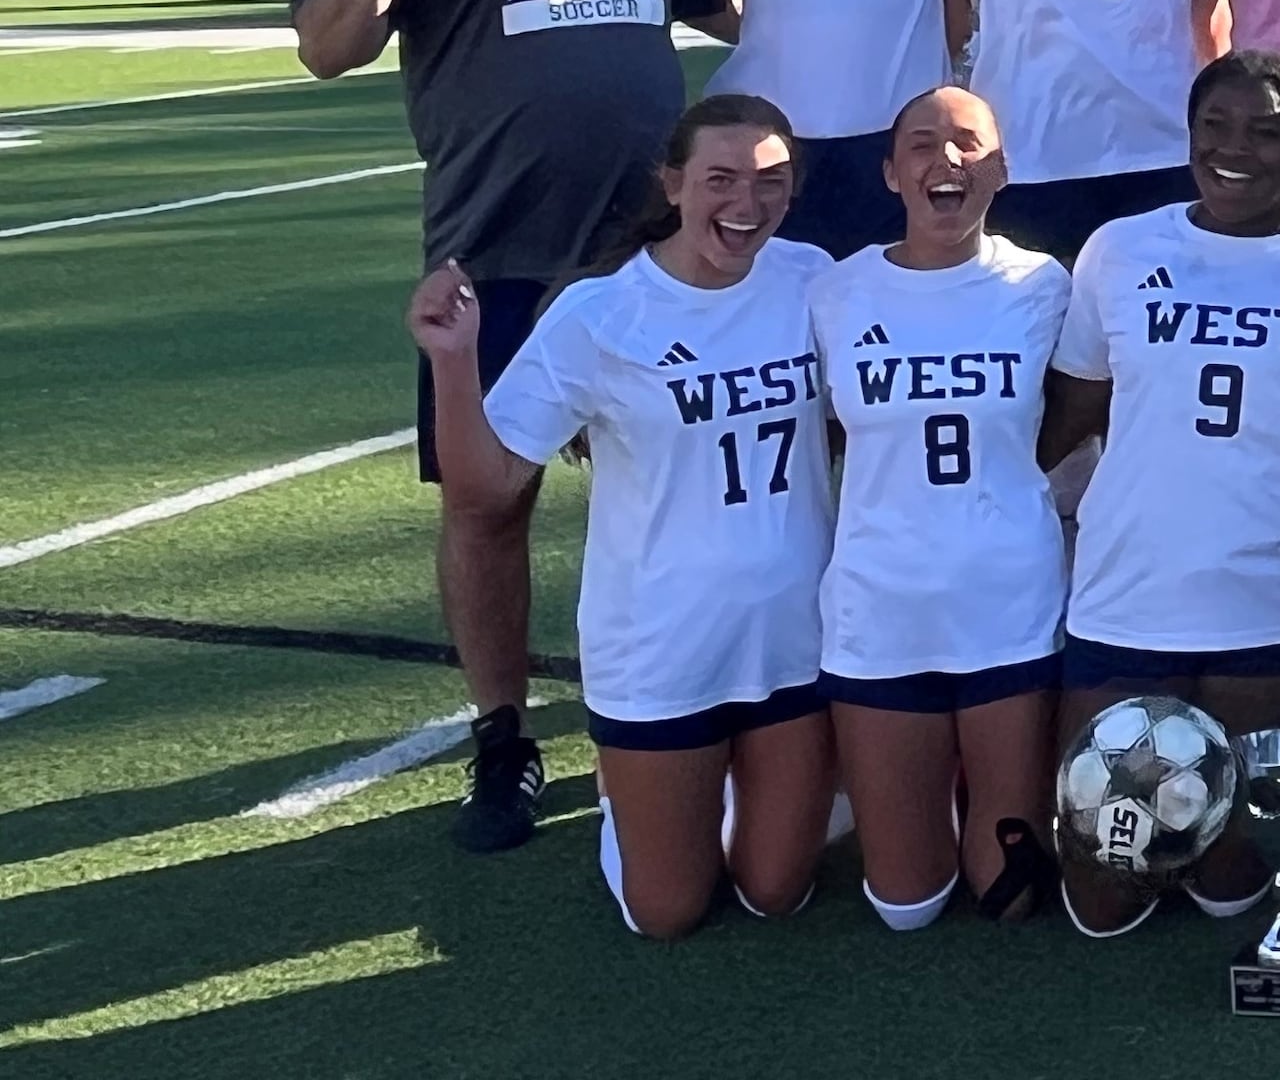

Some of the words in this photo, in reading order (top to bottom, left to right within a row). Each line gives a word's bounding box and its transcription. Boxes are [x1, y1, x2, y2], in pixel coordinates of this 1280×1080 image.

[666, 352, 818, 425] WEST
[855, 352, 1022, 405] WEST
[1195, 363, 1245, 438] 9
[718, 418, 797, 506] 17
[924, 414, 971, 486] 8
